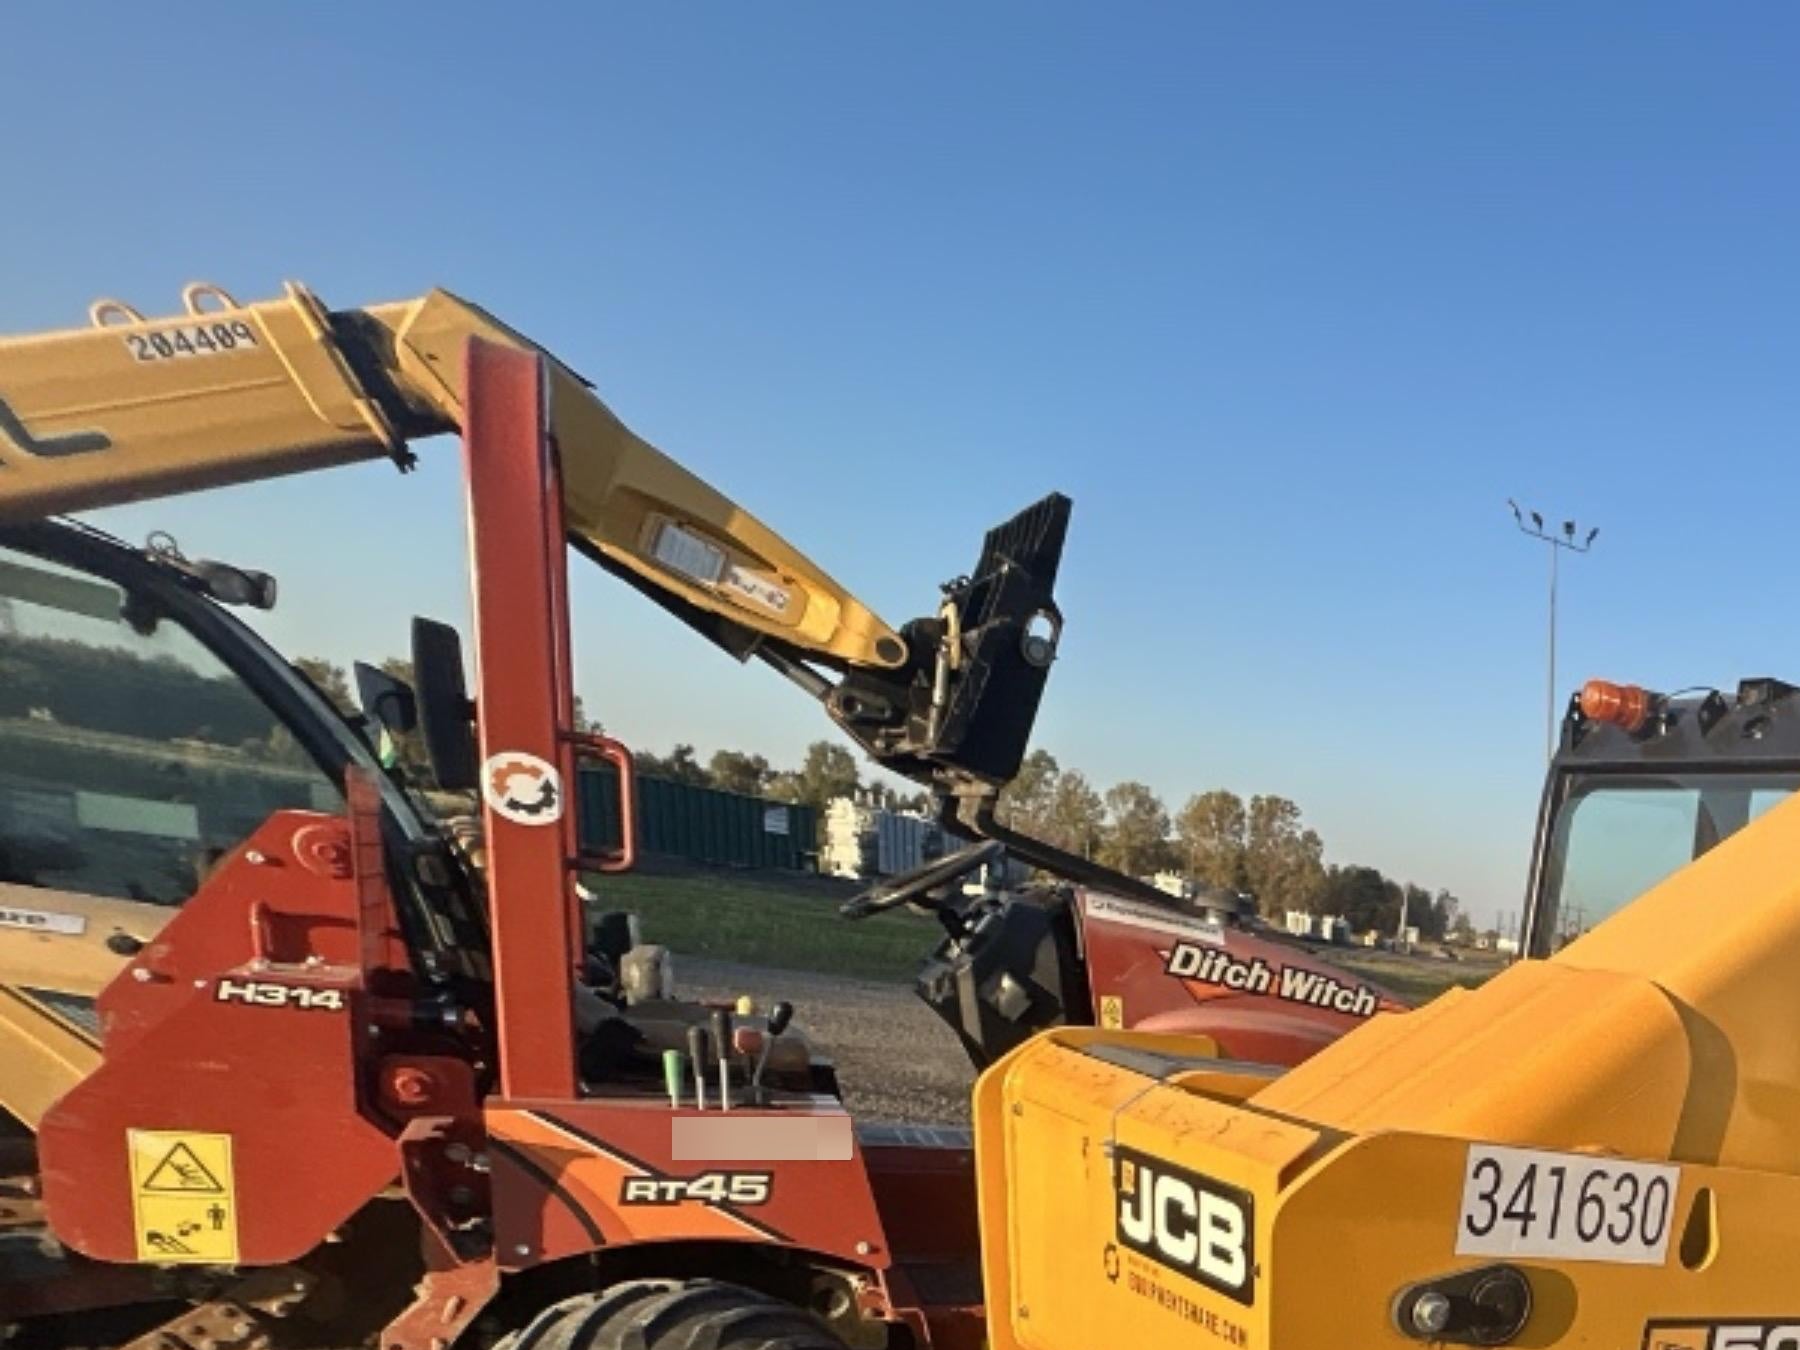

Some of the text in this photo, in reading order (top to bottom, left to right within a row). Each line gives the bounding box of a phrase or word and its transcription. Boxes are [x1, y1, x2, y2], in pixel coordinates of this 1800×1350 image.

[126, 320, 259, 361] 204409
[217, 980, 343, 1009] H314
[1168, 943, 1377, 1016] Ditch Witch
[626, 1174, 769, 1203] RT45
[1465, 1157, 1670, 1247] 341630
[1120, 1160, 1246, 1288] JCB
